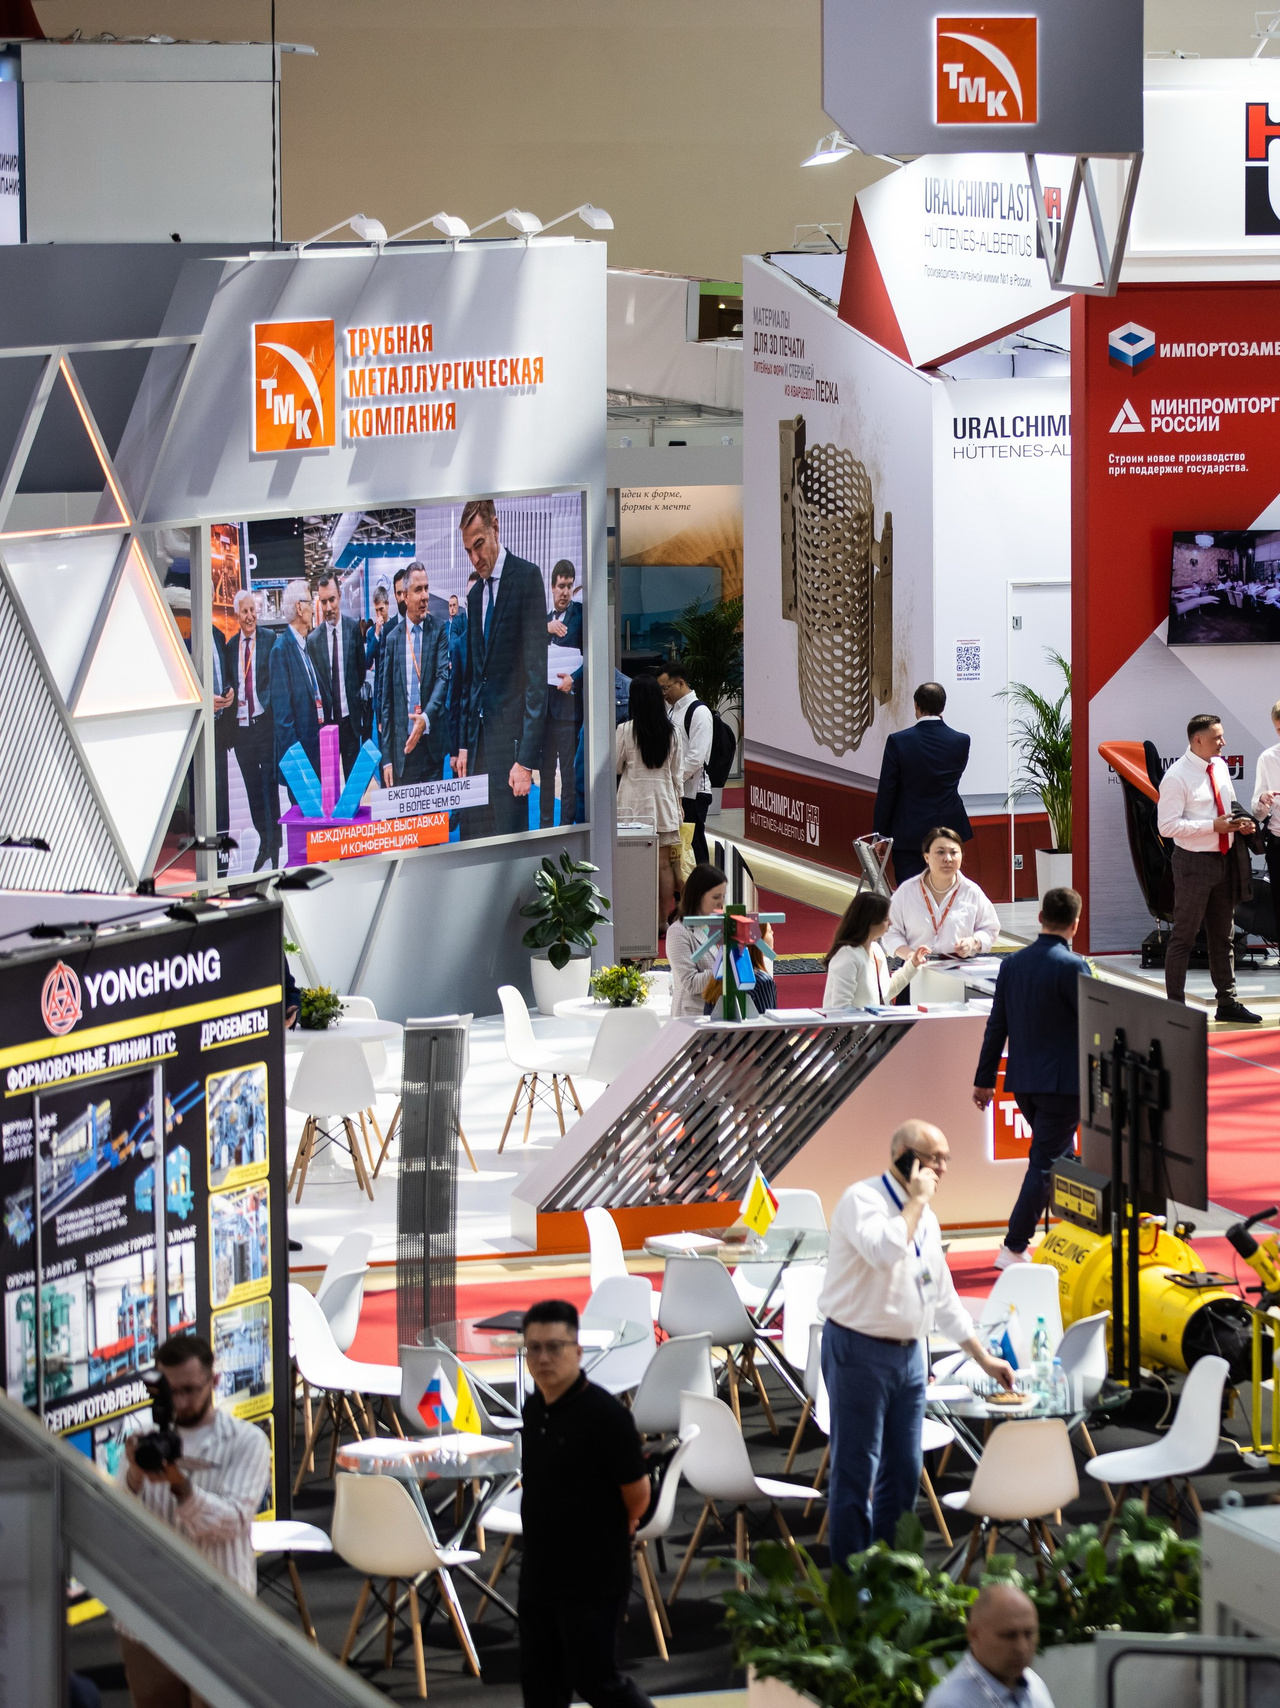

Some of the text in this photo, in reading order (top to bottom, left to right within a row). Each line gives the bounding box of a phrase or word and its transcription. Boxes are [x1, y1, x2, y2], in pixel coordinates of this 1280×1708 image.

[942, 62, 1008, 117] ТМК
[924, 176, 1032, 222] URALCHIMPLAST
[924, 222, 1033, 257] HÜTTENES-ALBERTUS
[753, 307, 791, 330] МАТЕРИАЛЫ
[347, 324, 433, 357] ТРУБНАЯ
[753, 331, 805, 360] ДЛЯ 3D ПЕЧАТИ
[349, 357, 544, 398] МЕТАЛЛУРГИЧЕСКАЯ
[815, 379, 839, 404] ПЕСКА
[261, 379, 312, 439] ТМК
[349, 403, 456, 438] КОМПАНИЯ
[1151, 397, 1280, 415] МИНПРОМТОРГ
[953, 415, 1071, 439] URALCHIM
[1151, 416, 1220, 433] РОССИИ
[1108, 453, 1246, 465] Строим новое производство
[1108, 464, 1249, 477] при поддержке государства.
[621, 489, 642, 498] идеи
[651, 489, 682, 500] форме,
[621, 502, 652, 513] формы
[661, 503, 692, 511] мечте
[388, 779, 471, 801] ЕЖЕГОДНОЕ УЧАСТИЕ
[399, 796, 461, 813] В БОЛЕЕ ЧЕМ 50
[750, 785, 805, 823] URALCHIMPLAST
[310, 815, 445, 844] МЕЖДУНАРОДНЫХ ВЫСТАВКАХ
[340, 833, 419, 854] И КОНФЕРЕНЦИЯХ
[84, 948, 221, 1009] YONGHONG
[200, 1009, 268, 1048] ДРОБЕМЕТЫ
[6, 1030, 177, 1092] ФОРМОВОЧНЫЕ ЛИНИИ ПГС
[999, 1101, 1033, 1139] ТМ
